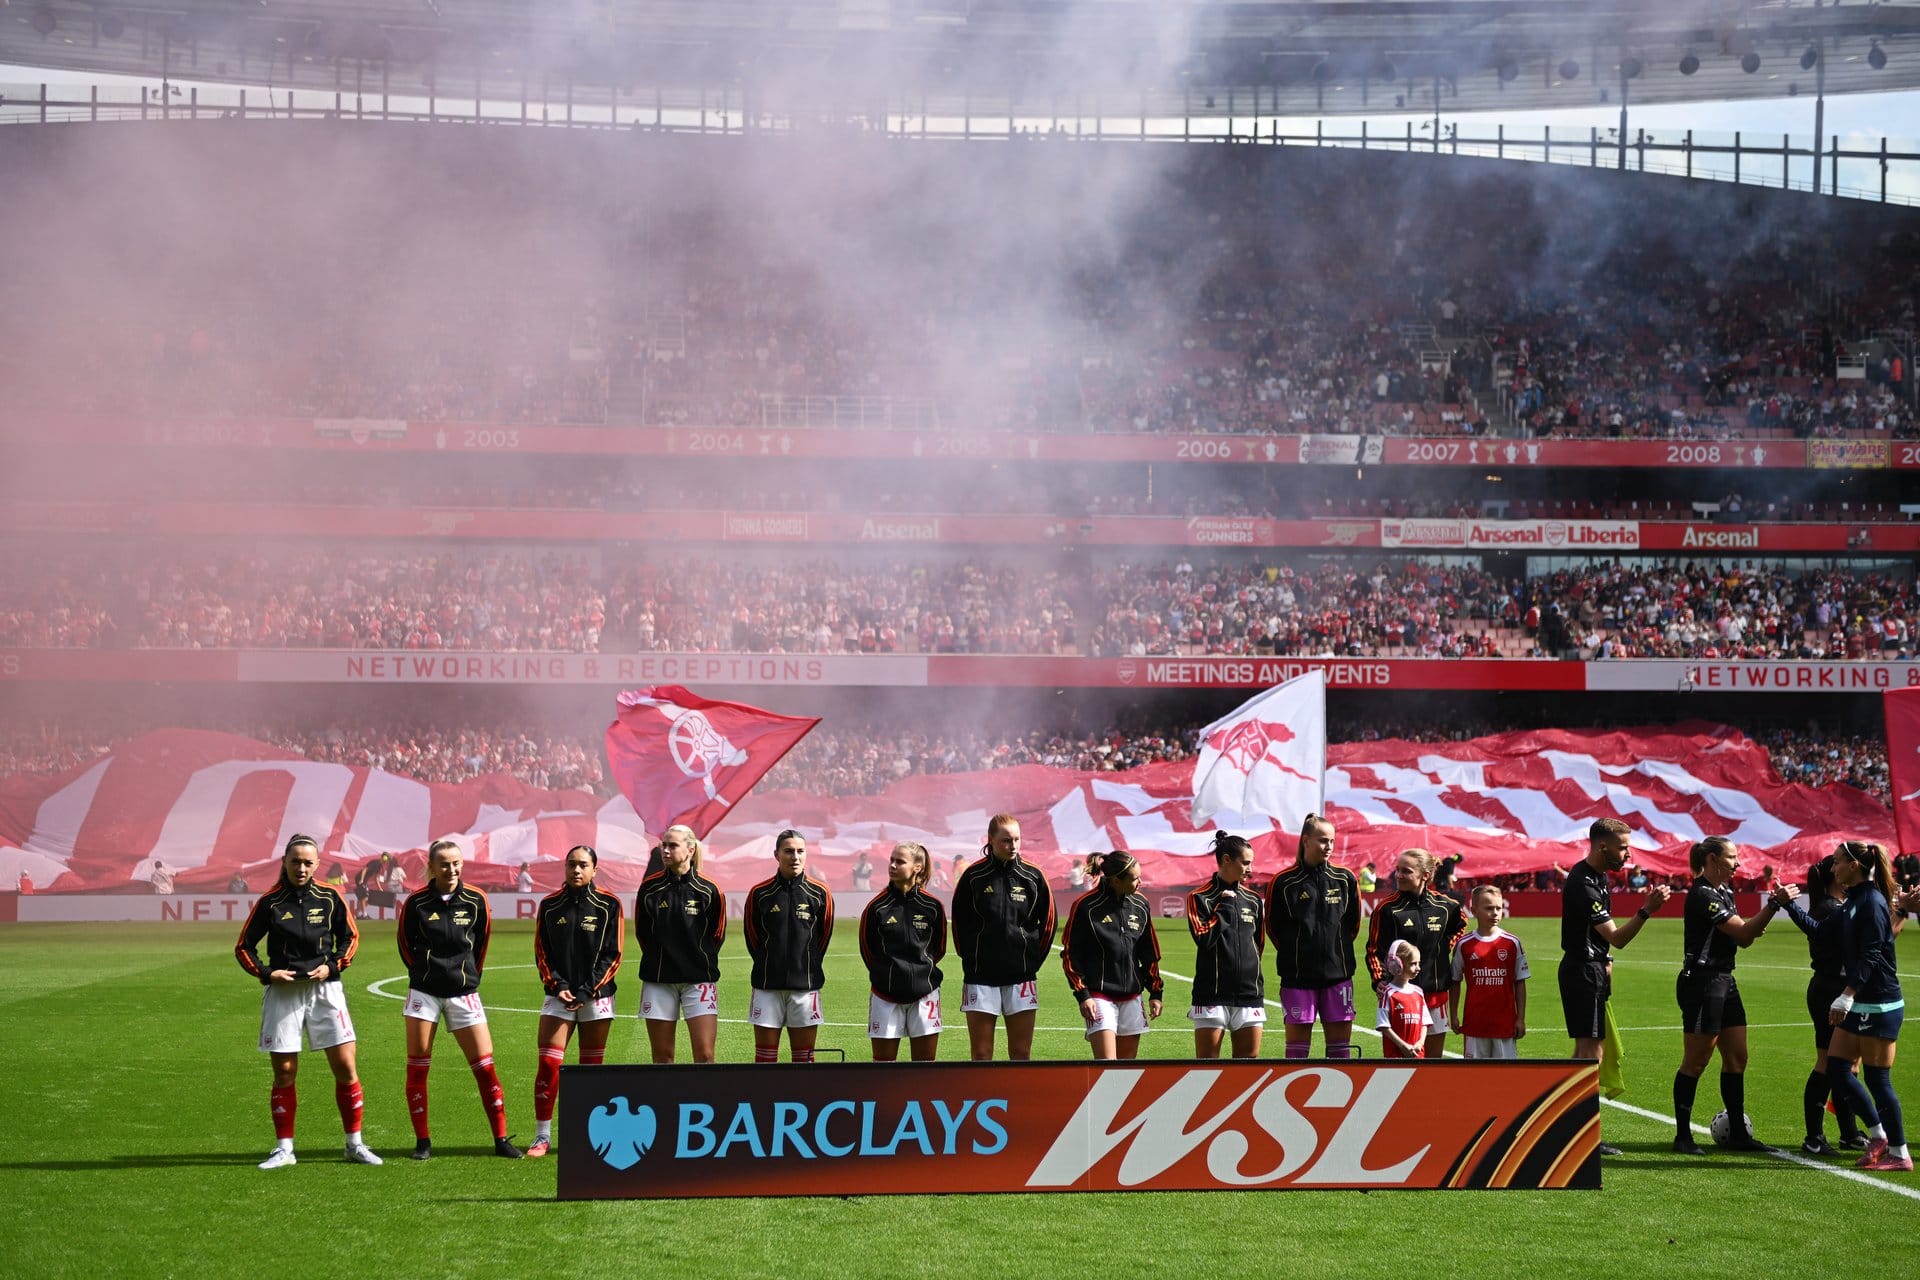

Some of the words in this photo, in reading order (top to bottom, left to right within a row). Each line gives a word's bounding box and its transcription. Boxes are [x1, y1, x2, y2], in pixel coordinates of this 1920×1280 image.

[463, 430, 520, 448] 2003
[688, 432, 745, 451] 2004
[1177, 441, 1232, 459] 2006
[1407, 444, 1460, 461] 2007
[1667, 446, 1721, 463] 2008
[861, 518, 939, 539] Arsenal
[1196, 531, 1254, 543] GUNNERS
[1469, 521, 1543, 543] Arsenal
[1568, 525, 1638, 544] Liberia
[1682, 527, 1759, 548] Arsenal
[347, 656, 566, 679] NETWORKING
[583, 659, 601, 679] &
[617, 658, 823, 681] RECEPTIONS
[1147, 663, 1253, 683] MEETINGS
[697, 984, 717, 1003] 23
[809, 992, 818, 1012] 7
[675, 1098, 1009, 1159] BARCLAYS
[1024, 1066, 1432, 1187] WSL
